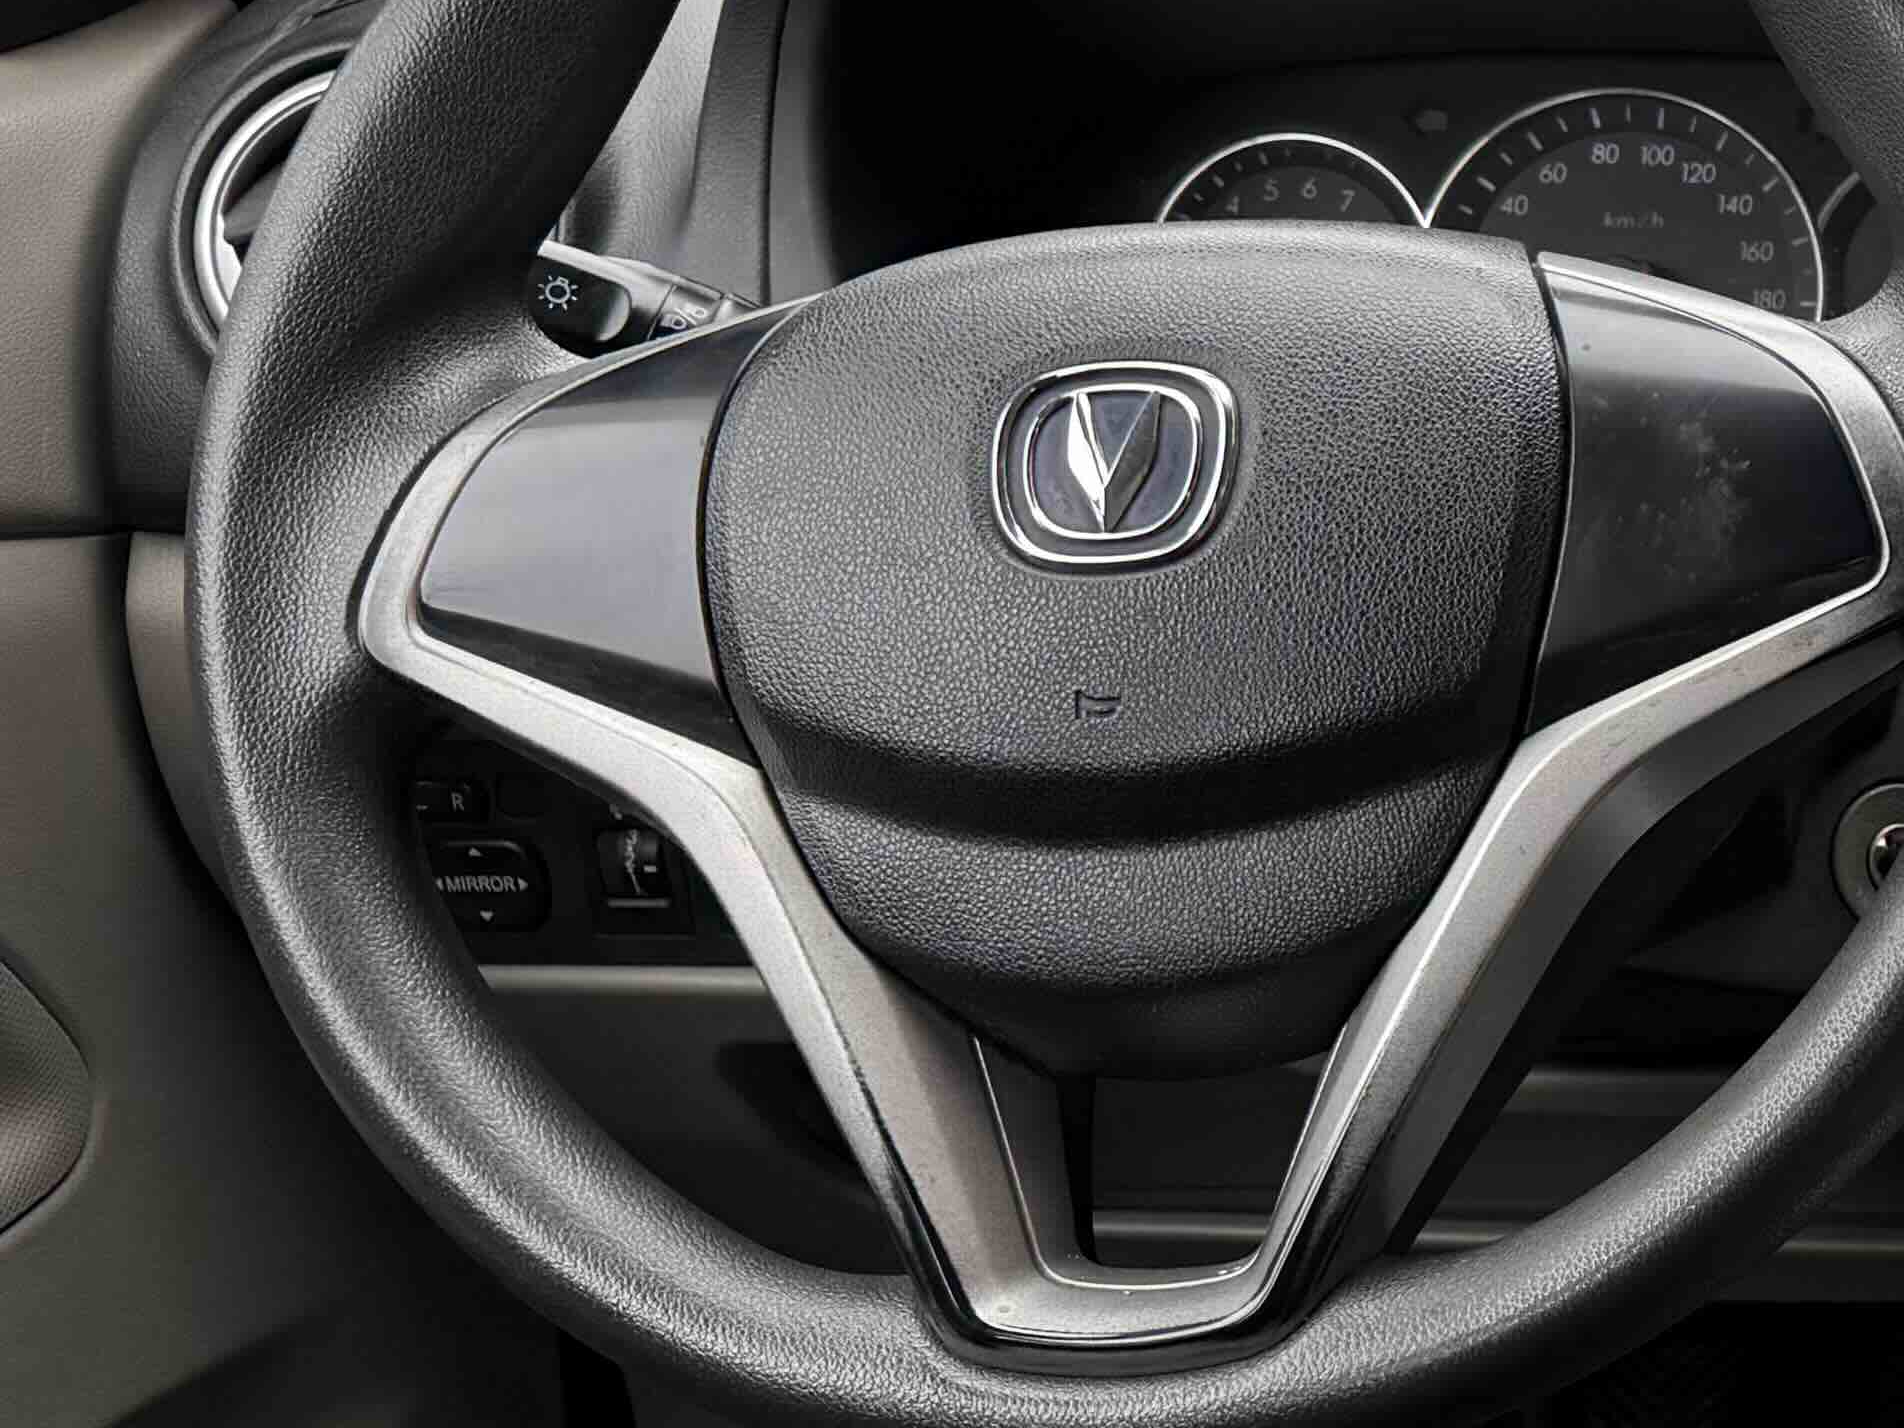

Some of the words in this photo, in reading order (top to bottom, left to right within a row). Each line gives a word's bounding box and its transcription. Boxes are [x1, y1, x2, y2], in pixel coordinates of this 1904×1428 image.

[1592, 143, 1620, 165] 80
[1640, 144, 1675, 167] 100
[1539, 162, 1568, 185] 60
[1681, 162, 1717, 184] 120
[1226, 196, 1239, 214] 4
[1263, 179, 1280, 202] 5
[1301, 176, 1317, 200] 6
[1339, 188, 1356, 211] 7
[1500, 194, 1529, 217] 40
[1717, 193, 1754, 217] 140
[1740, 240, 1774, 263] 160
[1752, 288, 1787, 311] 180
[451, 792, 465, 811] R
[445, 875, 516, 892] MIRROR
